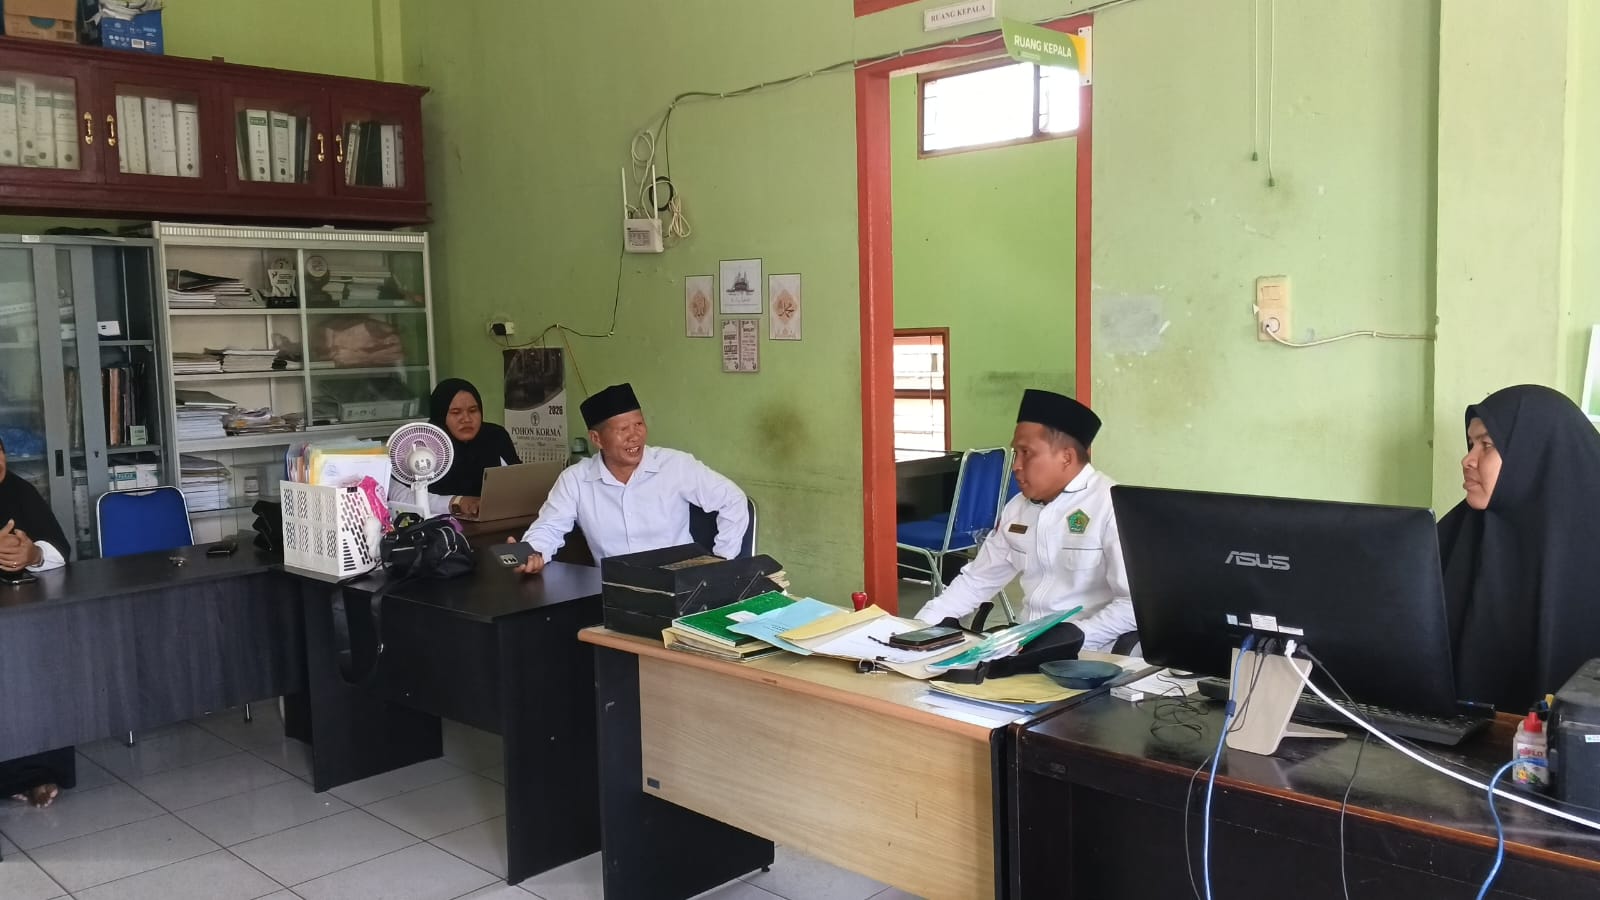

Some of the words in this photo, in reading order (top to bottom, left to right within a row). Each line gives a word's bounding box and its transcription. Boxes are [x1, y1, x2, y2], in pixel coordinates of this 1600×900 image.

[930, 10, 956, 22] RUANG
[957, 4, 986, 17] KEPALA
[1014, 34, 1042, 51] RUANG
[1043, 40, 1072, 58] KEPALA
[548, 405, 563, 415] 2026
[511, 426, 534, 436] POHON
[535, 427, 561, 437] KORMA
[1225, 550, 1291, 571] ASUS
